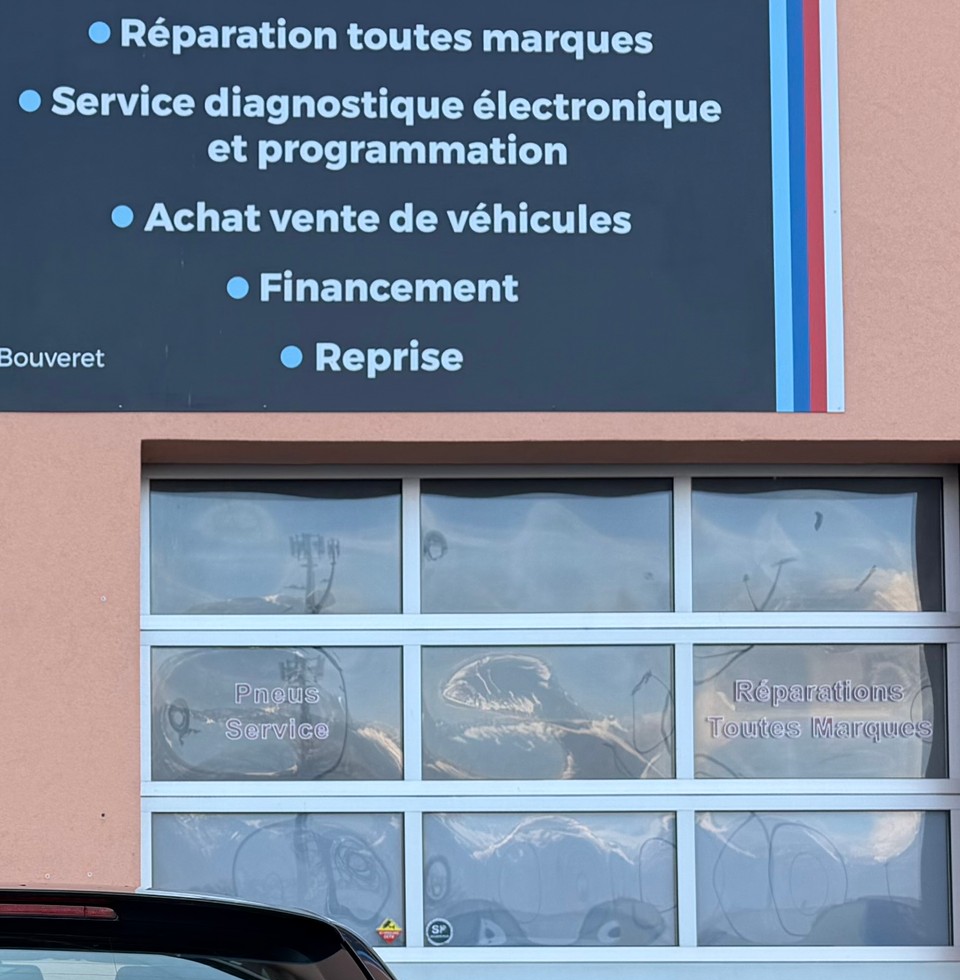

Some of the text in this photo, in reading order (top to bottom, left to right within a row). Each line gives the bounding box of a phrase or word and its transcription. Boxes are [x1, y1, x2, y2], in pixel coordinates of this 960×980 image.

[121, 16, 653, 60] Réparation toutes marques
[51, 84, 722, 129] Service diagnostique électronique
[207, 133, 567, 171] et programmation
[143, 201, 632, 234] Achat vente de véhicules
[260, 269, 519, 303] Financement
[316, 339, 464, 379] Reprise
[234, 682, 320, 704] Pneus
[734, 679, 904, 706] Réparations
[225, 718, 329, 740] Service
[707, 716, 933, 743] Toutes Marques
